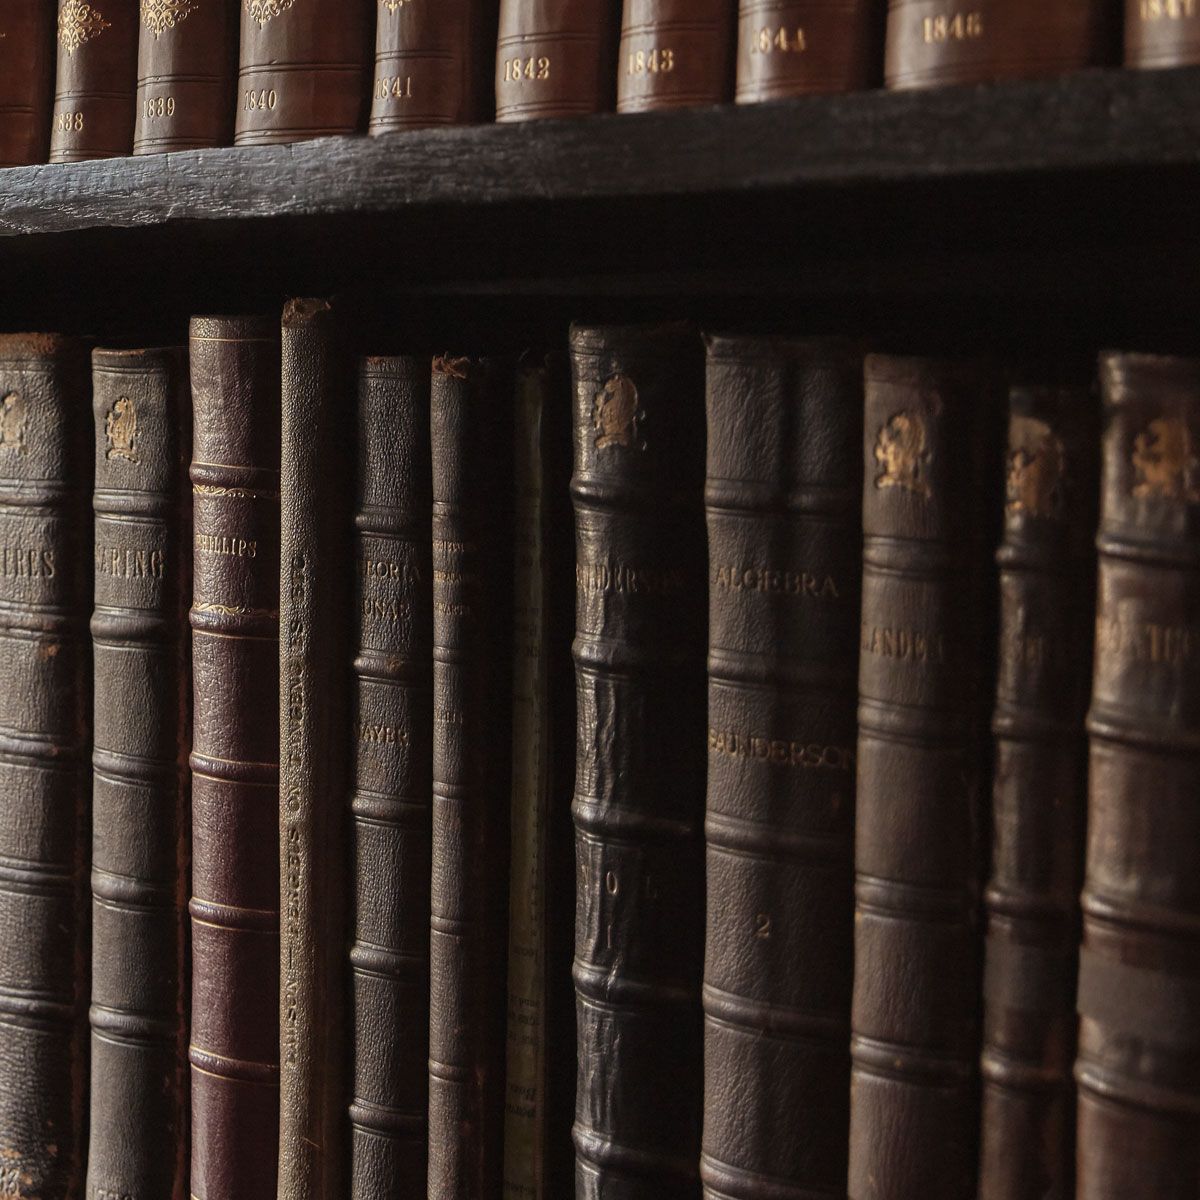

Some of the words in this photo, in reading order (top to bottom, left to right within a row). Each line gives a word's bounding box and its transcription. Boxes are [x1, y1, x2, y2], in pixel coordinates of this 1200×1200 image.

[503, 56, 551, 83] 1842
[244, 89, 278, 111] 1840
[374, 76, 414, 100] 1841
[142, 96, 175, 120] 1839
[714, 566, 840, 598] ALGEBRA
[287, 784, 302, 813] ON
[755, 913, 771, 938] 2
